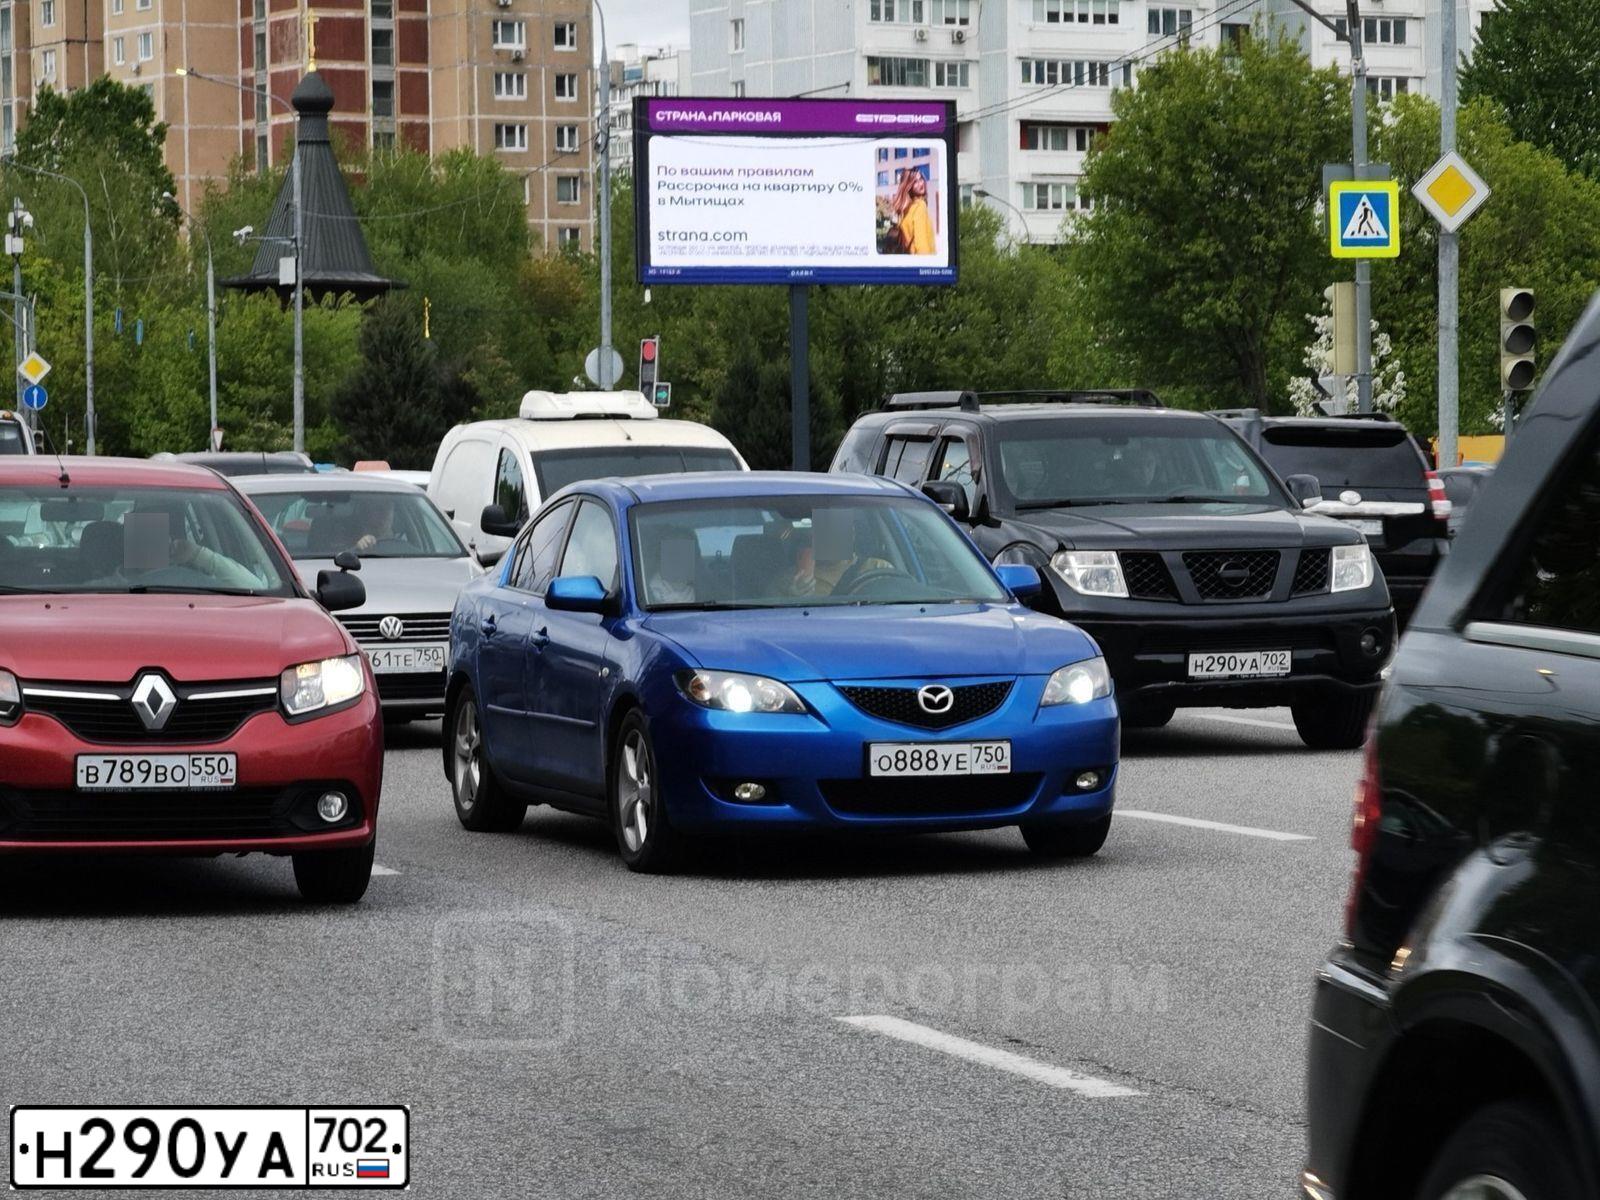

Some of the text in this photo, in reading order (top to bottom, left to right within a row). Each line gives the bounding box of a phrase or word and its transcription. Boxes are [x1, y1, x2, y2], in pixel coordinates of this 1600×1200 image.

[657, 165, 815, 178] По вашим правилам
[657, 180, 864, 194] Рассрочка на квартиру 0%
[657, 195, 745, 207] в Мытищах
[657, 229, 748, 241] strana.com
[416, 648, 439, 662] 750
[1194, 652, 1287, 673] Н290УА 702
[878, 746, 1004, 772] О888УЕ 750
[85, 757, 229, 784] В789ВО 550
[200, 774, 220, 784] RUS
